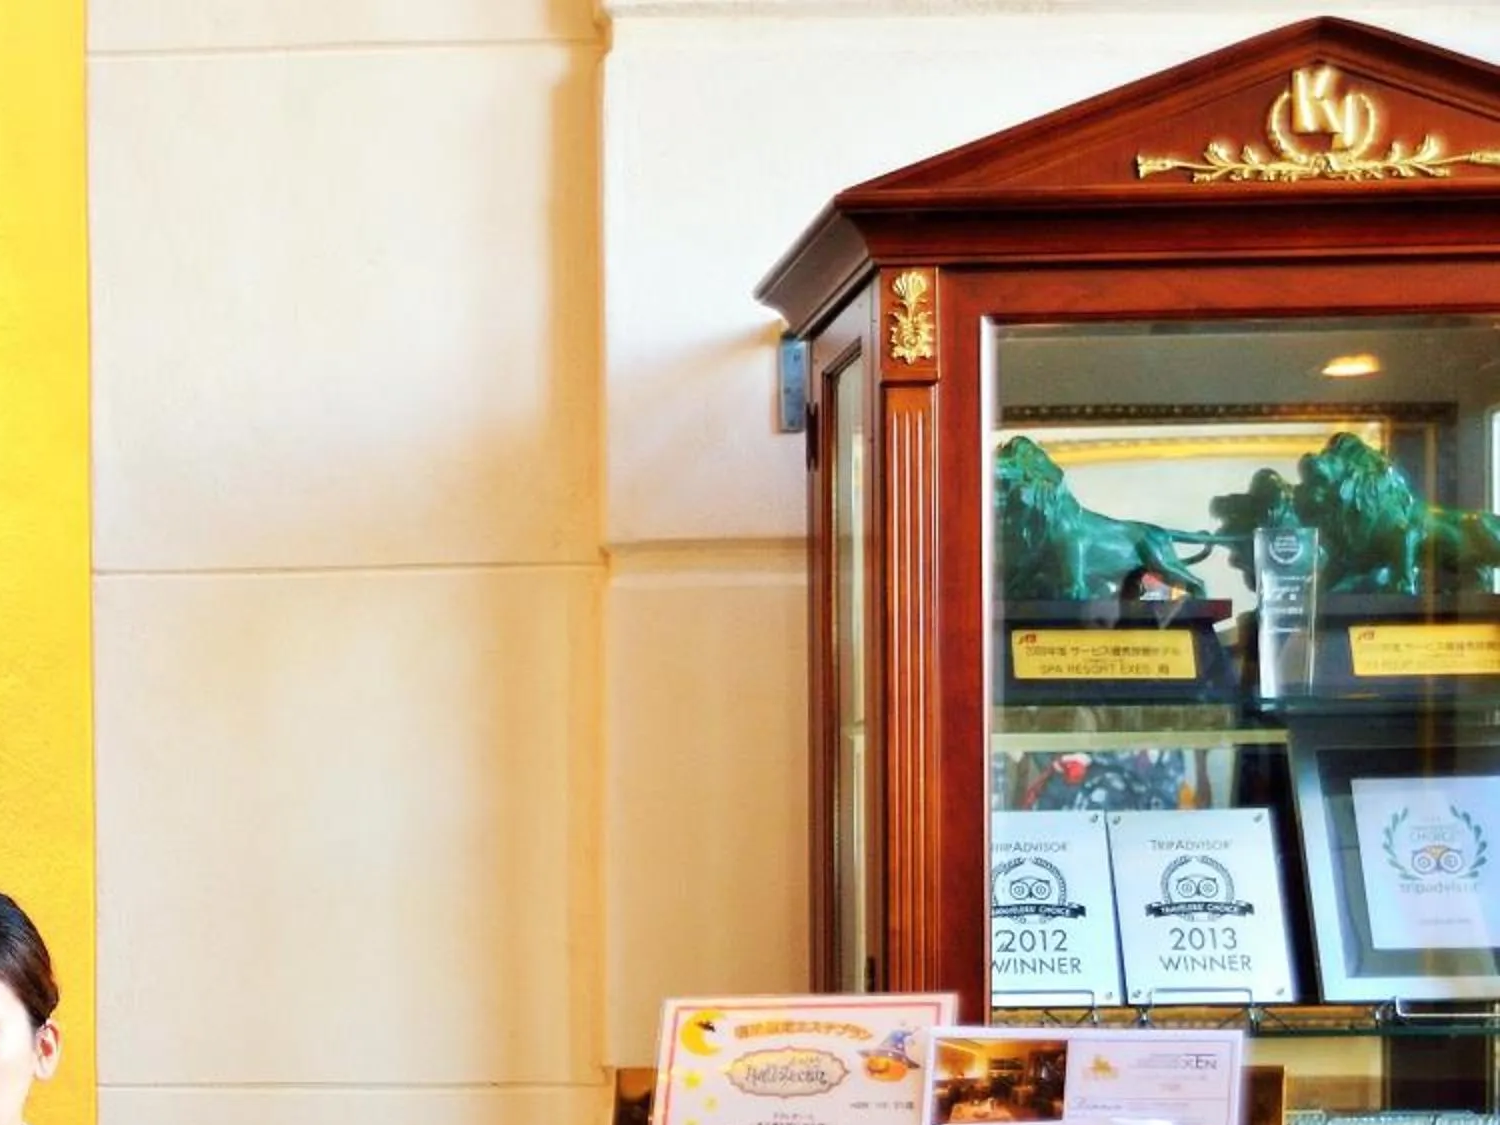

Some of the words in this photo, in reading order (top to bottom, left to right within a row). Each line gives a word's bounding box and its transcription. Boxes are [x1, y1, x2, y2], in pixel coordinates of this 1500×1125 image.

[995, 930, 1068, 953] 2012
[1169, 927, 1237, 951] 2013
[1159, 955, 1252, 972] WINNER
